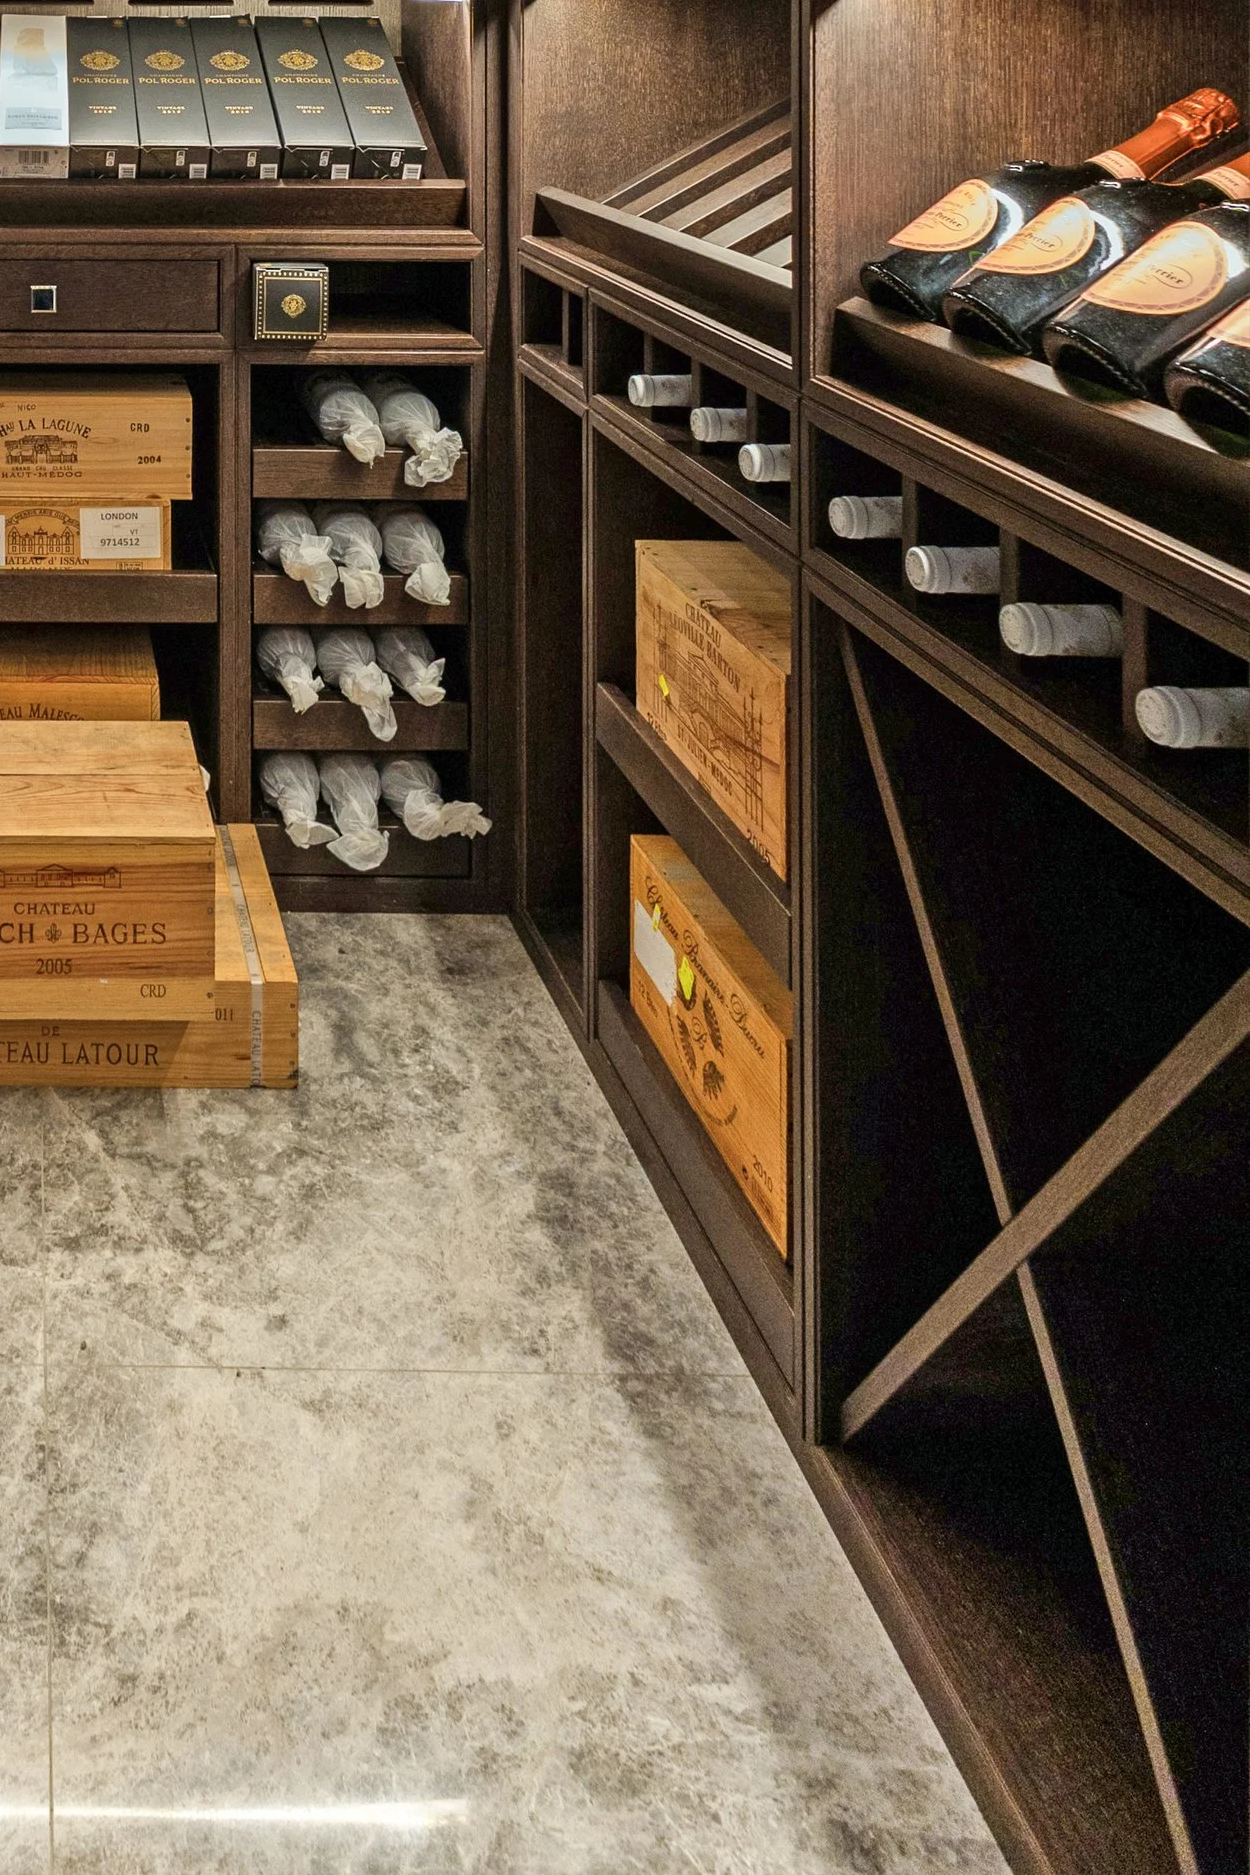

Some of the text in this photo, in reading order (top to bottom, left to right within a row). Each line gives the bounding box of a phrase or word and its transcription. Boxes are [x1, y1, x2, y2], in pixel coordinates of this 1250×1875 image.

[94, 77, 129, 85] ROGER
[160, 77, 196, 85] ROGER
[227, 77, 262, 85] ROGER
[296, 77, 332, 85] ROGER
[341, 76, 400, 85] POL ROGER
[18, 418, 36, 431] LA
[41, 417, 92, 439] LAGUNE
[130, 422, 150, 433] CRD
[137, 455, 162, 464] 2004
[100, 512, 139, 521] LONDON
[100, 538, 140, 547] 9714512
[5, 557, 43, 565] ATEAU
[59, 557, 90, 566] ISSAN
[706, 639, 740, 693] BARTON
[13, 902, 96, 915] CHATEAU
[72, 922, 167, 944] BAGES
[36, 957, 73, 974] 2005
[140, 983, 167, 998] CRD
[215, 1007, 234, 1021] 011
[41, 1025, 60, 1037] DE
[61, 1041, 159, 1066] LATOUR
[252, 1010, 262, 1086] CHATEAU LATO
[753, 1153, 773, 1193] 2010
